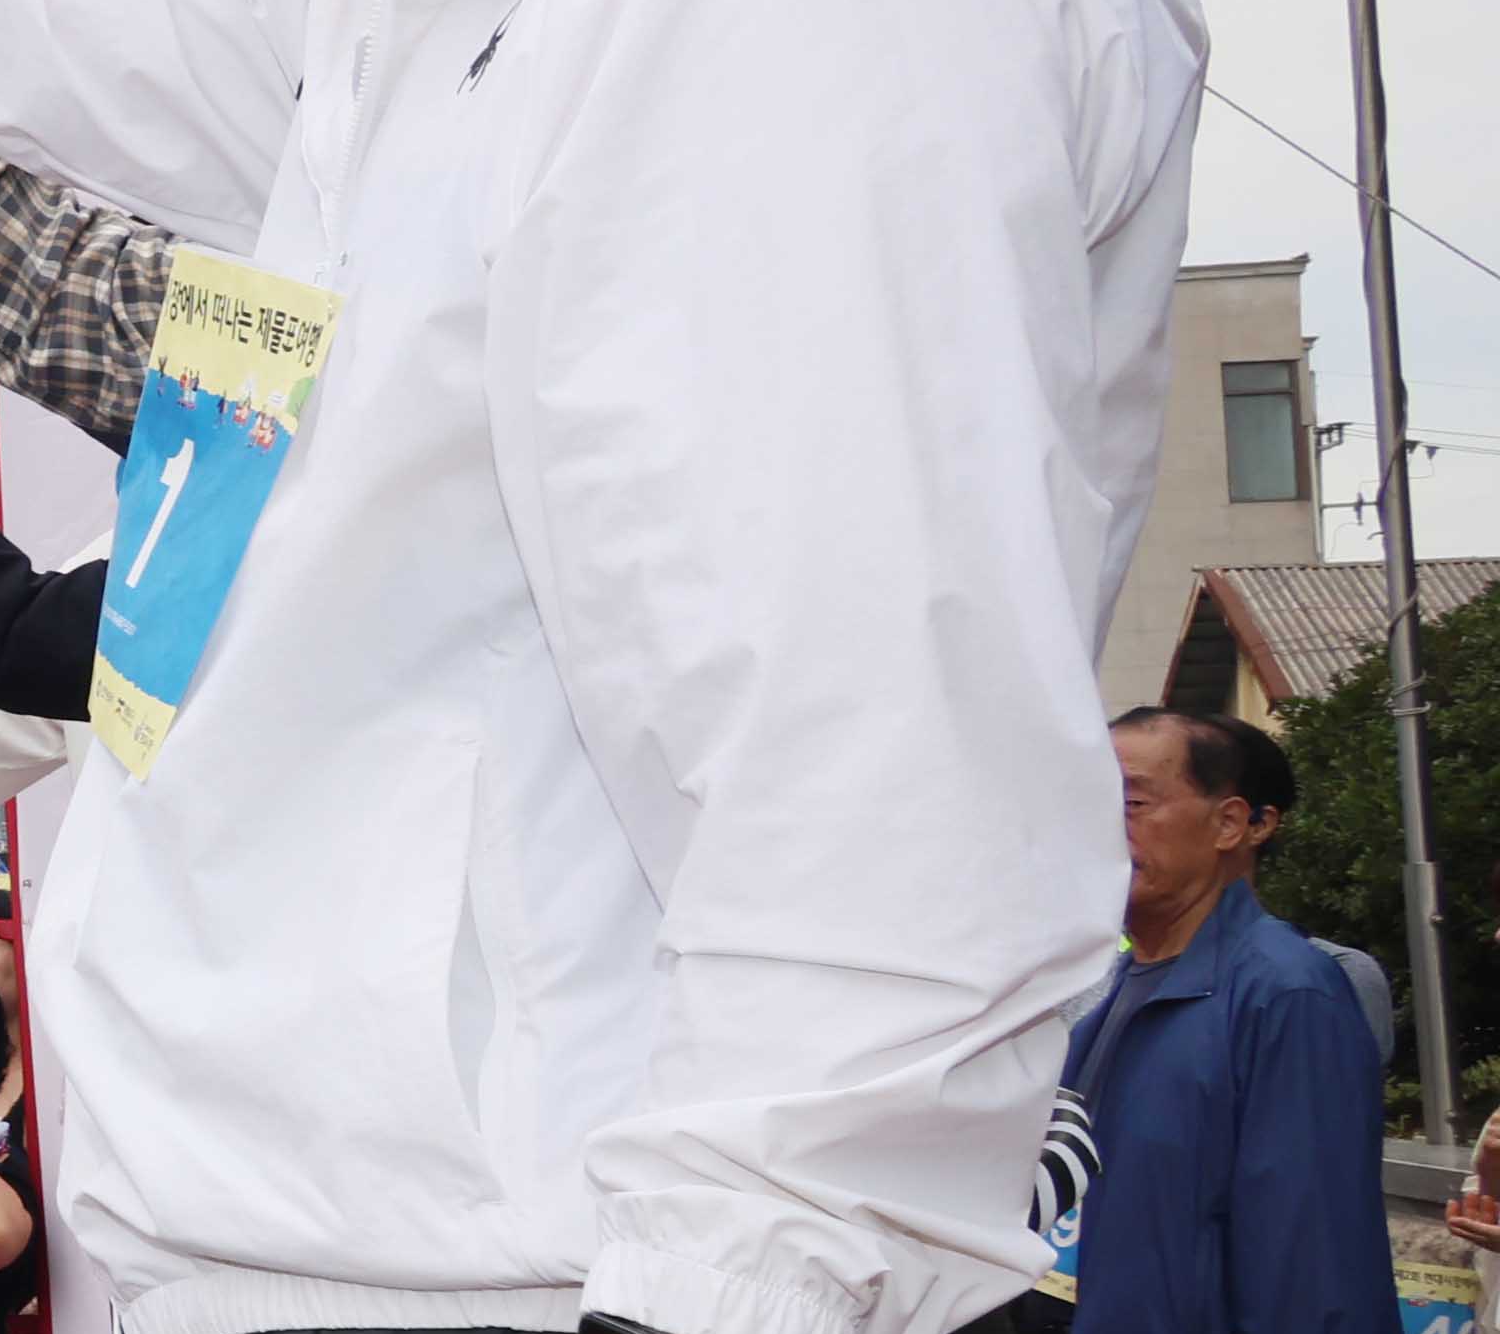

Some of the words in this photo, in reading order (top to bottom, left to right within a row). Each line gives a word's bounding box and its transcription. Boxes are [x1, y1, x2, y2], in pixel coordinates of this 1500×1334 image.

[164, 281, 209, 331] 장에서
[211, 292, 254, 345] 떠나는
[256, 305, 322, 368] 제물포여행
[125, 438, 196, 590] 1
